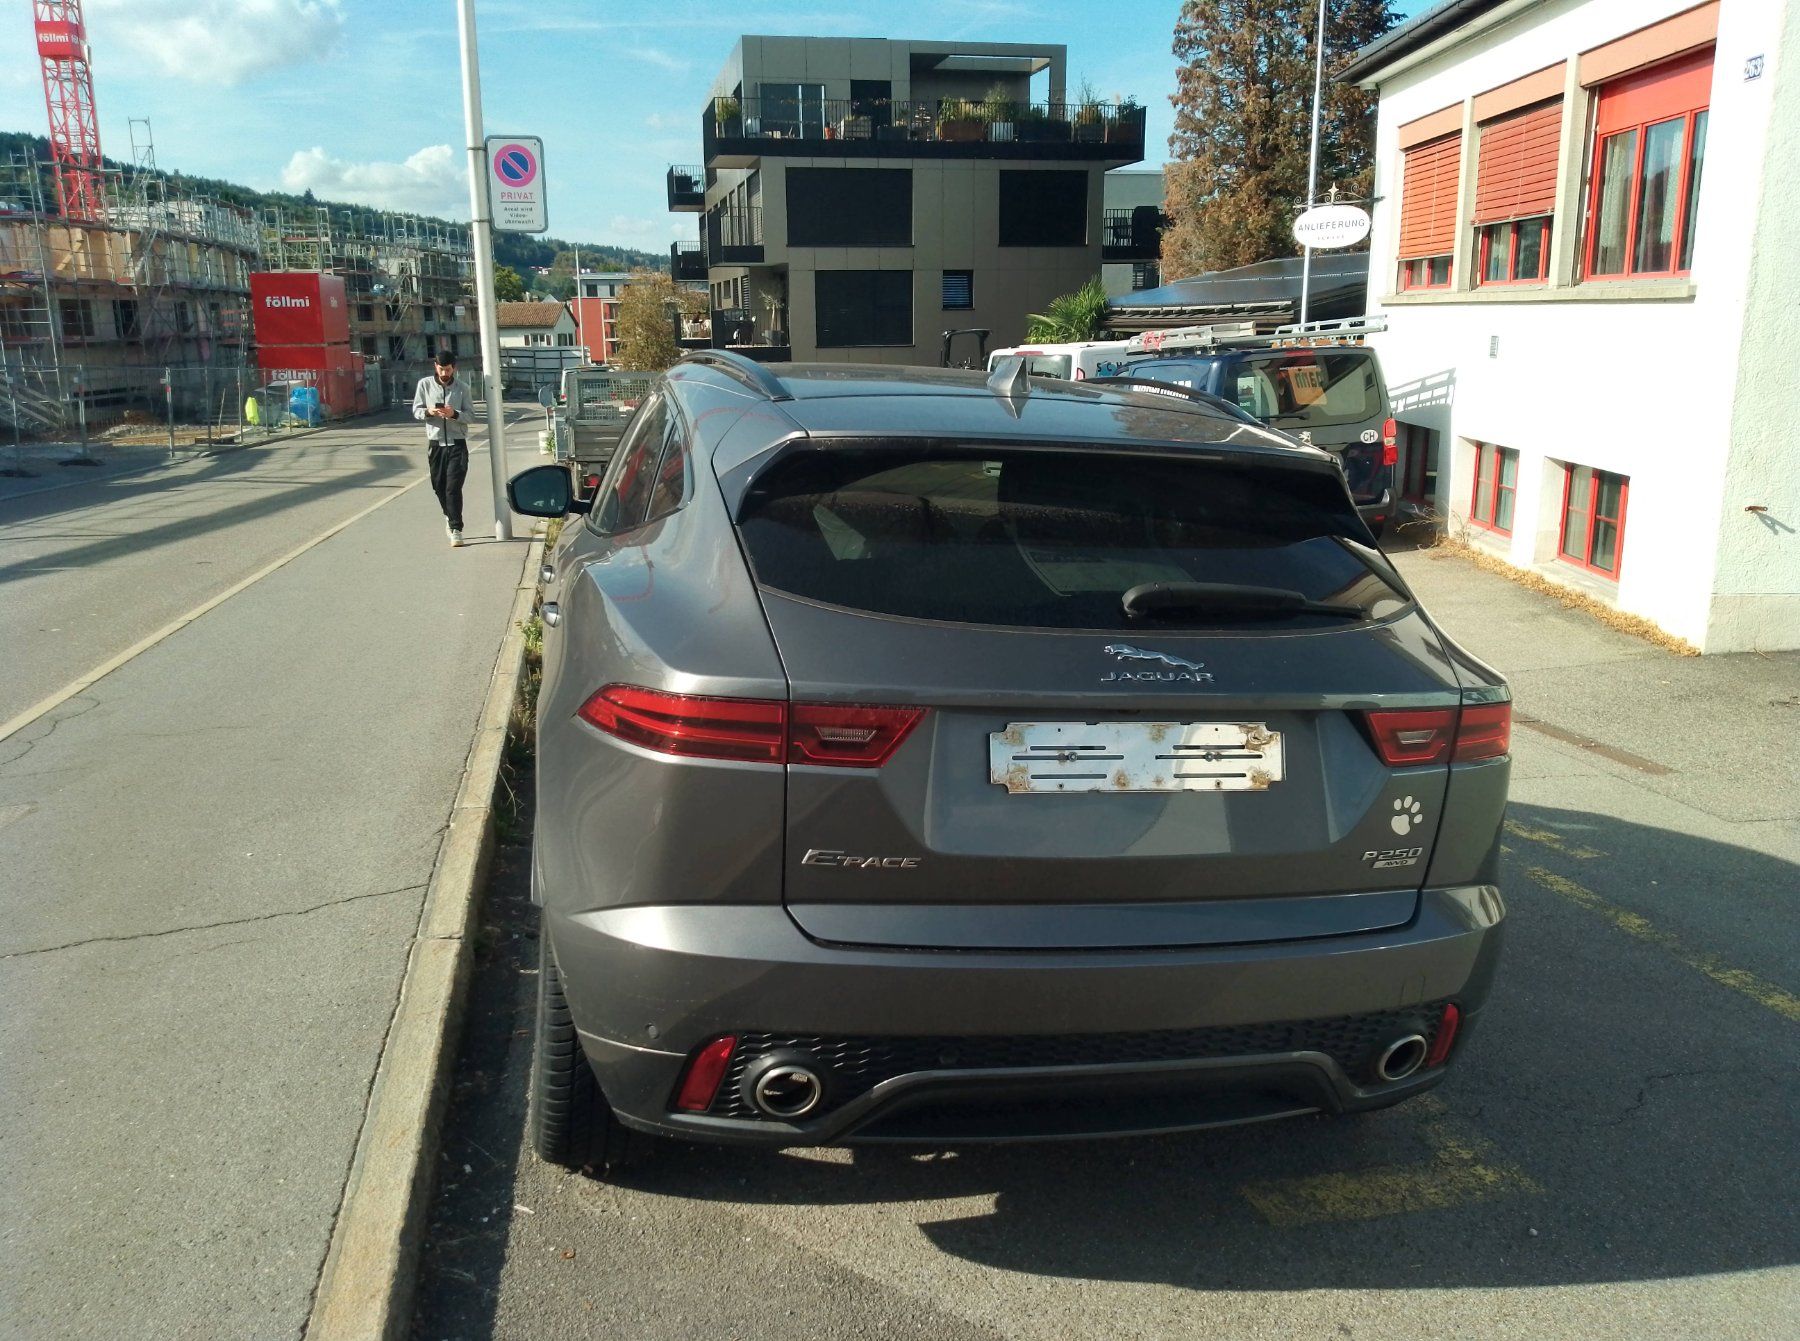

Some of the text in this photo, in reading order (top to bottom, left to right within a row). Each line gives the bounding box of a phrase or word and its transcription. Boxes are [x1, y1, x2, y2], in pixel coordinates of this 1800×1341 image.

[39, 33, 69, 43] föllmi
[500, 191, 534, 200] PRIVAT
[1298, 218, 1366, 231] ANLIEFERUNG
[265, 296, 310, 308] föllmi
[271, 368, 317, 381] föllmi
[1362, 432, 1375, 441] CH
[1100, 672, 1215, 682] JAGUAR
[1361, 847, 1423, 861] P250
[1383, 859, 1408, 867] AWD
